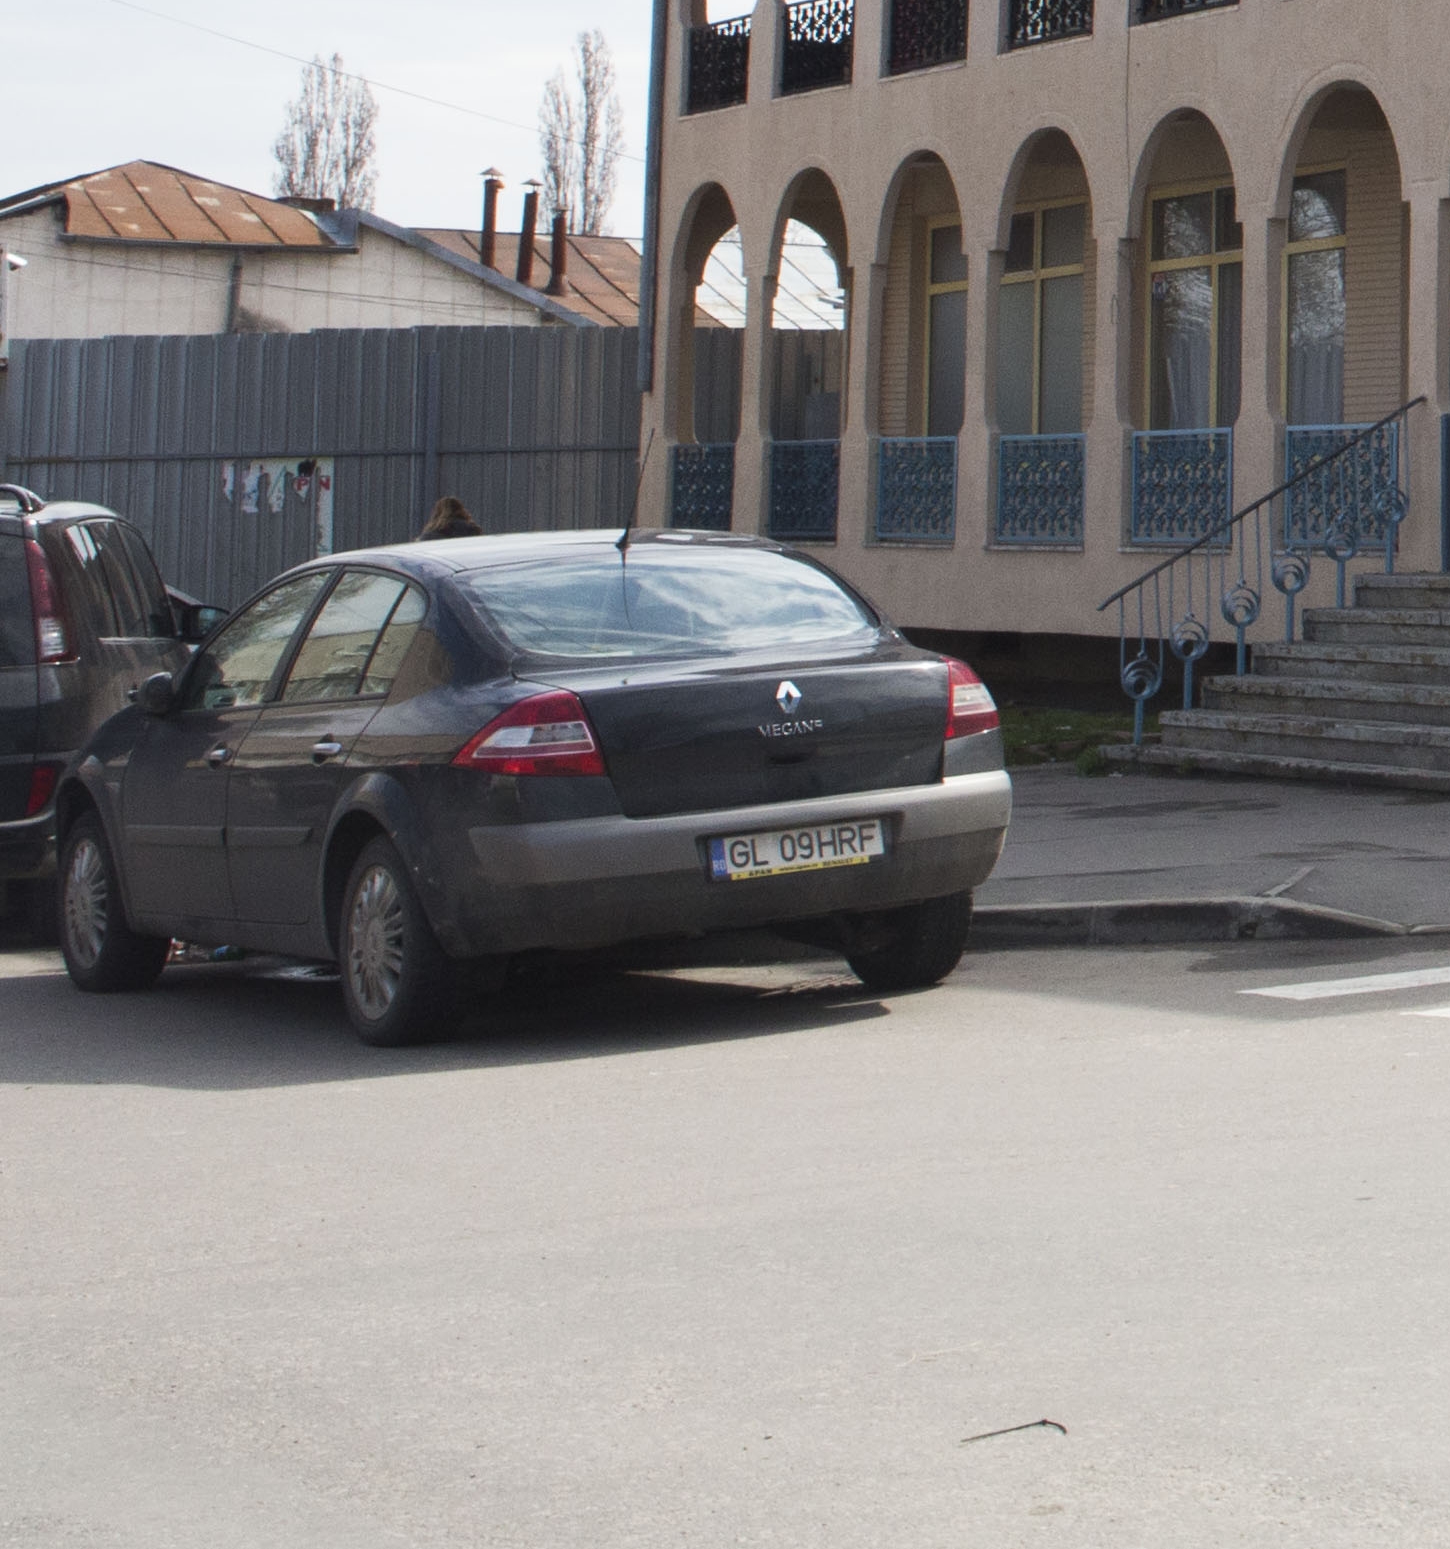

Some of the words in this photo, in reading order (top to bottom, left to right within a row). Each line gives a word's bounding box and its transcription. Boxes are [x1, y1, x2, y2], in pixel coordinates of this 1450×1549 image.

[757, 719, 823, 737] MEGANE
[730, 839, 769, 868] GL
[780, 824, 876, 862] 09HRF
[712, 859, 726, 871] RO
